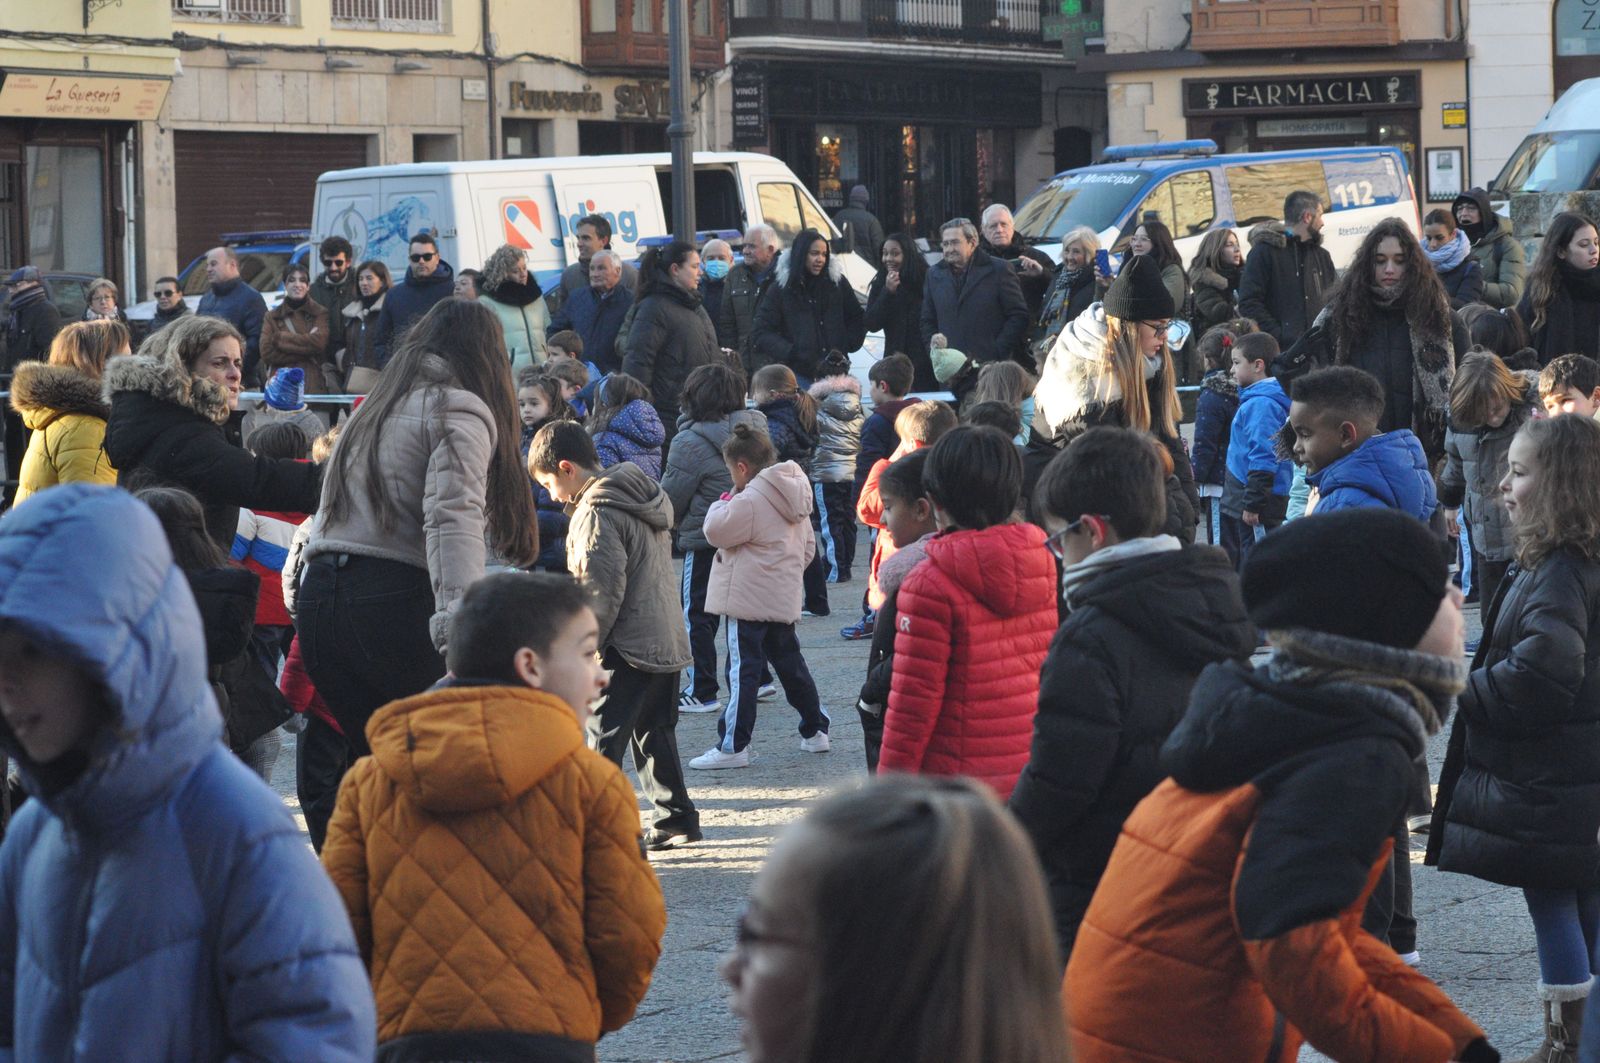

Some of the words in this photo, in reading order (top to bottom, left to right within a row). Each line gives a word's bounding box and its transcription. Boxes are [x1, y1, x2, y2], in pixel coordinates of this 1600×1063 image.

[1582, 10, 1600, 30] Z
[45, 77, 62, 101] La
[735, 87, 758, 95] VINOS
[1232, 81, 1373, 106] FARMACIA
[1081, 173, 1141, 186] Municipal
[1334, 180, 1375, 208] 112
